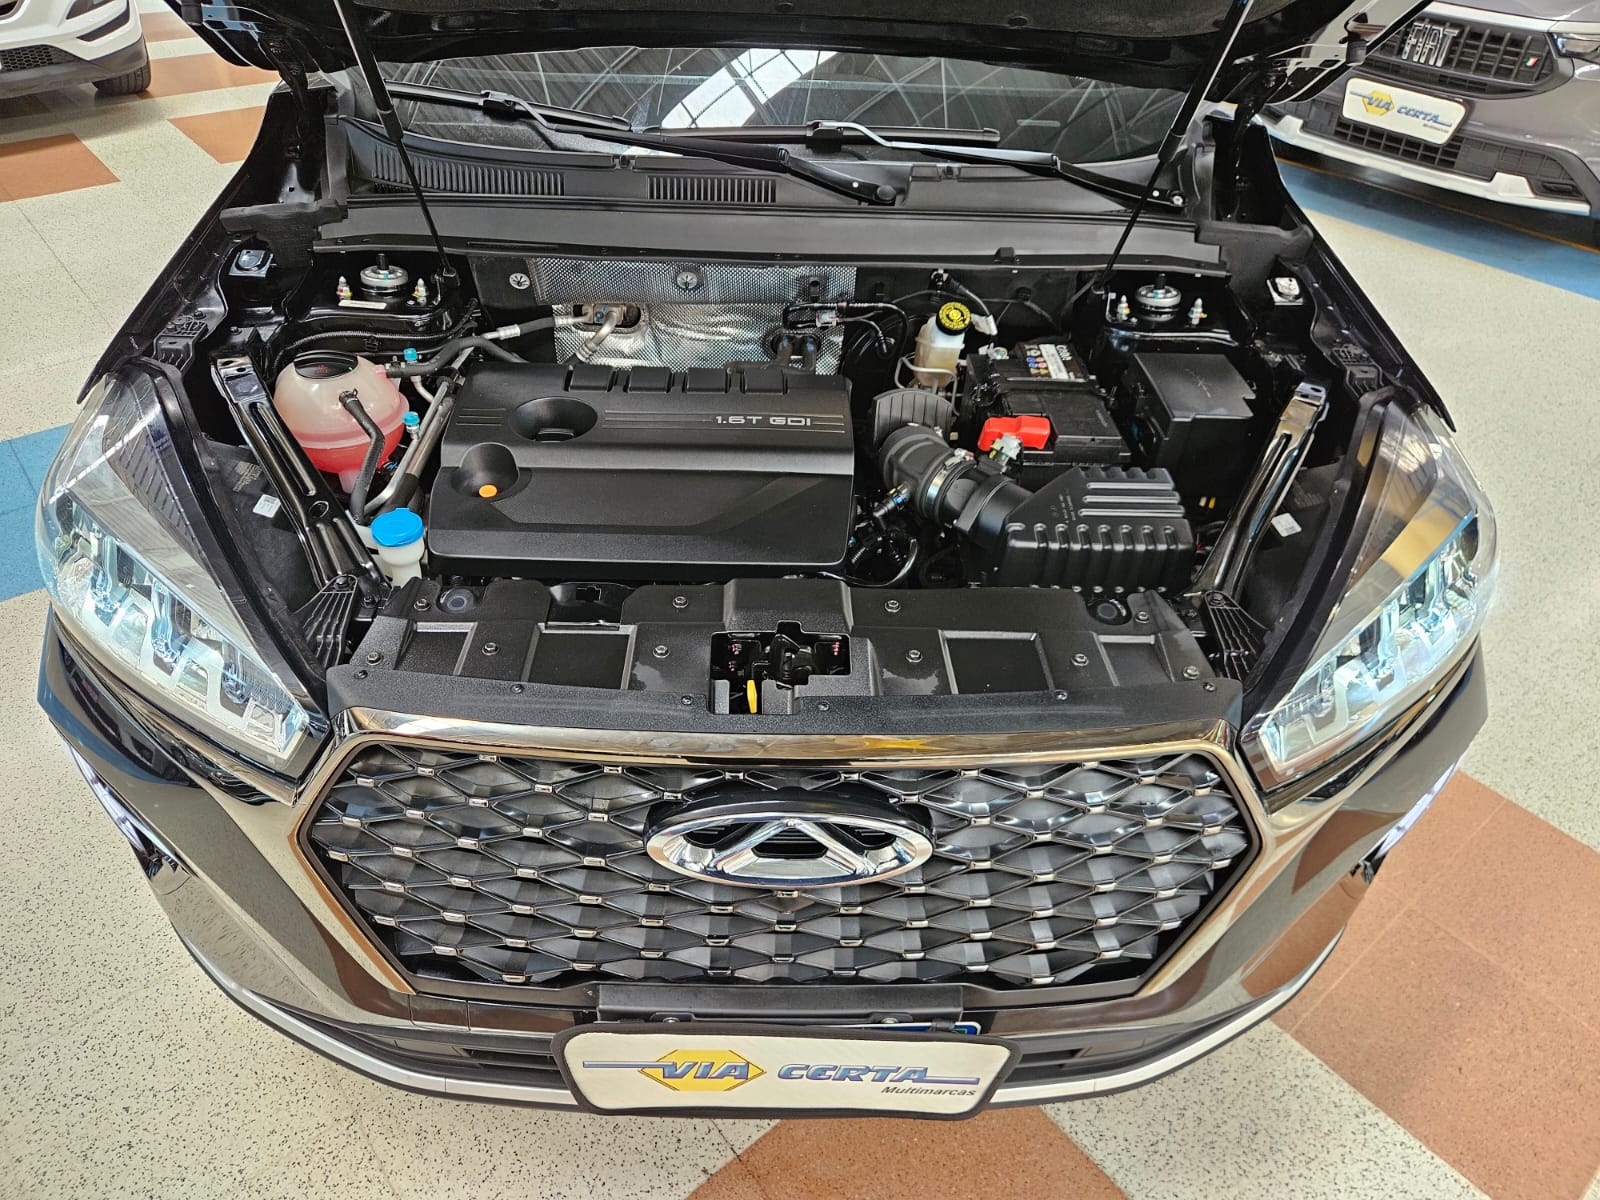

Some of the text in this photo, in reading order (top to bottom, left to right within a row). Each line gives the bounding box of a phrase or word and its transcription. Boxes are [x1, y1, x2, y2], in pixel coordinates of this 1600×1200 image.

[1402, 22, 1459, 67] FIAT
[1367, 96, 1439, 122] VIA CERTA
[715, 415, 811, 426] 1.6T GDI
[661, 1061, 928, 1084] VIA CERTA
[881, 1086, 976, 1096] Multimarcas
